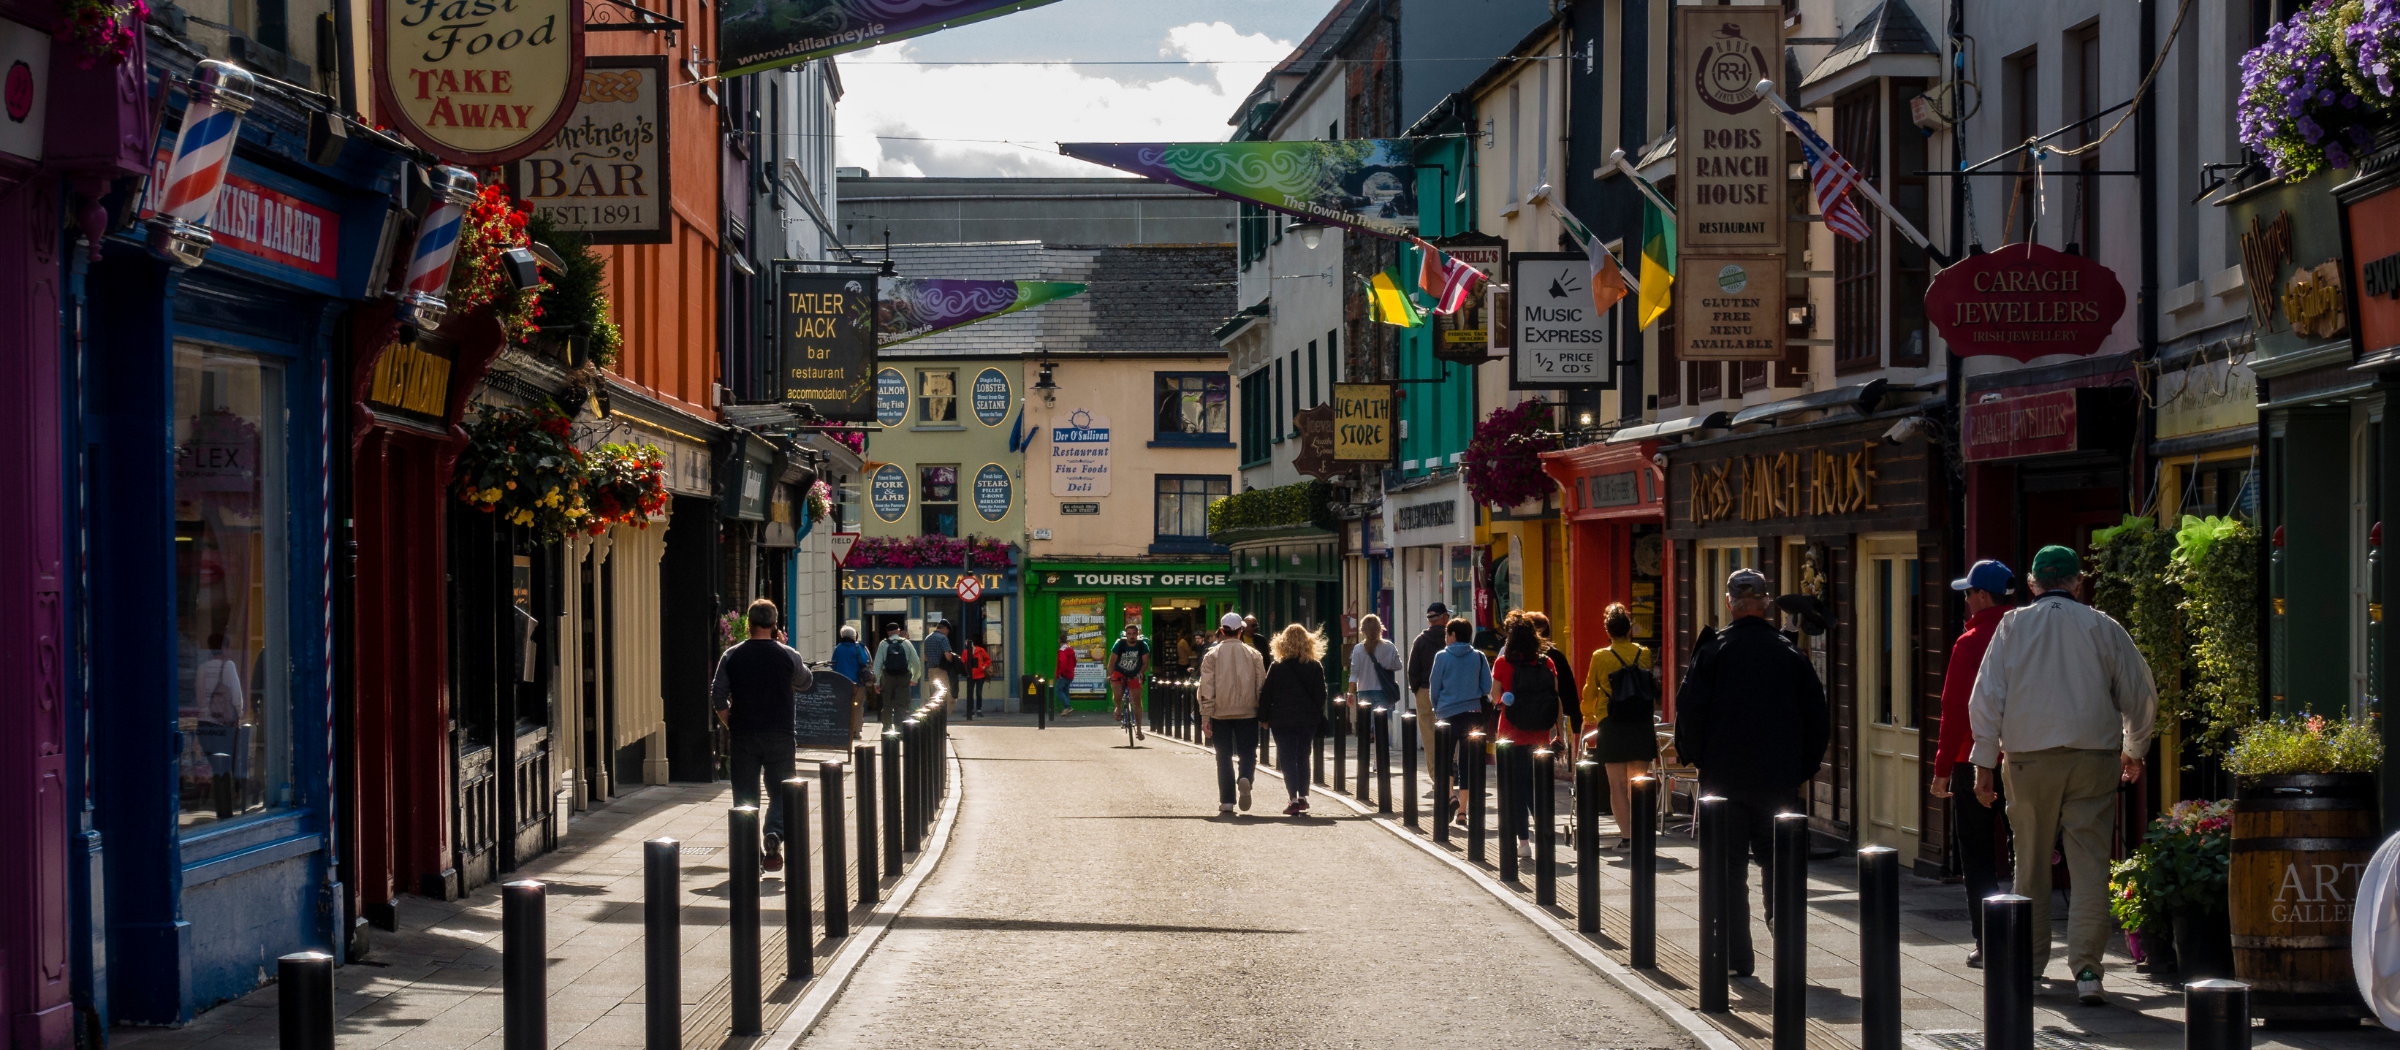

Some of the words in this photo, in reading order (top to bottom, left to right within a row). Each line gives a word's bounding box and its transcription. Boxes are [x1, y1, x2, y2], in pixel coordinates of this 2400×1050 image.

[401, 0, 518, 27] Fast
[422, 15, 556, 62] Food
[737, 22, 885, 66] www.killarney.ie
[1717, 62, 1747, 81] RRH
[409, 68, 513, 100] TAKE
[426, 96, 534, 129] AWAY
[539, 115, 654, 161] urtney's
[1703, 128, 1763, 150] ROBS
[1696, 156, 1770, 178] RANCH
[525, 159, 649, 198] BAR
[1696, 184, 1769, 206] HOUSE
[1283, 194, 1306, 211] The
[1308, 200, 1341, 220] Town
[1342, 210, 1355, 224] in
[1356, 213, 1378, 230] The
[1380, 222, 1410, 237] Park
[262, 198, 322, 263] BARBER
[1698, 222, 1765, 234] RESTAURANT
[1973, 270, 2080, 293] CARAGH
[788, 293, 844, 315] TATLER
[1702, 298, 1761, 308] GLUTEN
[1525, 306, 1583, 322] MUSIC
[1713, 312, 1751, 322] FREE
[1952, 301, 2100, 327] JEWELLERS
[795, 317, 836, 339] JACK
[1525, 327, 1603, 343] EXPRESS
[1709, 326, 1753, 335] MENU
[1690, 339, 1773, 349] AVAILABLE
[1973, 331, 2005, 342] IRISH
[2006, 330, 2078, 343] JEWELLERY
[807, 346, 831, 360] bar
[1559, 353, 1593, 362] PRICE
[791, 367, 844, 379] restaurant
[1562, 364, 1591, 374] CD'S
[787, 387, 847, 400] accommodation
[878, 386, 906, 395] ALMON
[976, 383, 1007, 393] LOBSTER
[891, 401, 905, 409] Fish
[976, 400, 989, 409] SEA
[989, 400, 1006, 409] TANK
[1334, 397, 1389, 420] HEALTH
[1969, 411, 2008, 446] CARAGH
[2009, 403, 2067, 446] JEWELLERS
[1055, 430, 1069, 441] Der
[1070, 430, 1109, 441] O'Sullivan
[1340, 424, 1384, 446] STORE
[1052, 446, 1109, 457] Restaurant
[1055, 464, 1077, 473] Fine
[1081, 464, 1108, 473] Foods
[875, 481, 904, 489] PORK
[1067, 483, 1092, 491] Deli
[1690, 457, 1734, 529] ROBS
[1741, 451, 1800, 523] RANCH
[1809, 441, 1880, 517] HOUSE
[1074, 574, 1154, 585] TOURIST
[1160, 574, 1226, 586] OFFICE
[2273, 862, 2369, 902] ART
